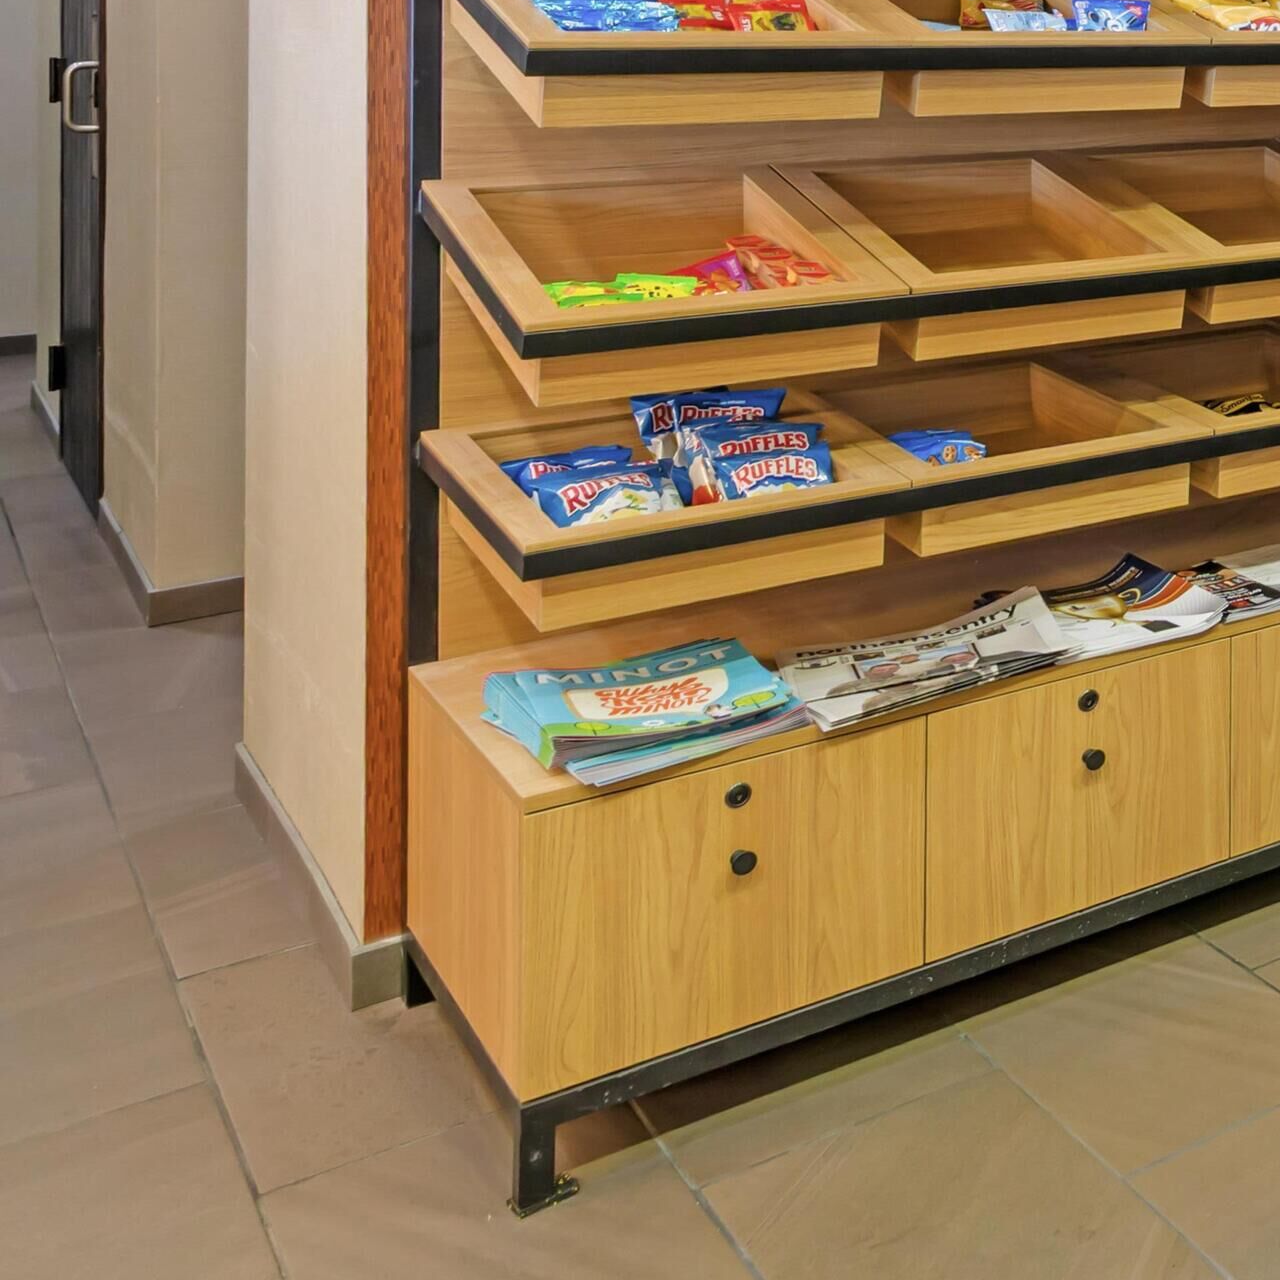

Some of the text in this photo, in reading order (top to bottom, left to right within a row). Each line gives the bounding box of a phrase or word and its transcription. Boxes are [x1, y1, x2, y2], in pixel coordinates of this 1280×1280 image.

[718, 432, 810, 457] RUFFLES
[733, 455, 818, 490] RUFFLES
[558, 472, 654, 517] RUFFLES
[534, 645, 733, 687] MINOT
